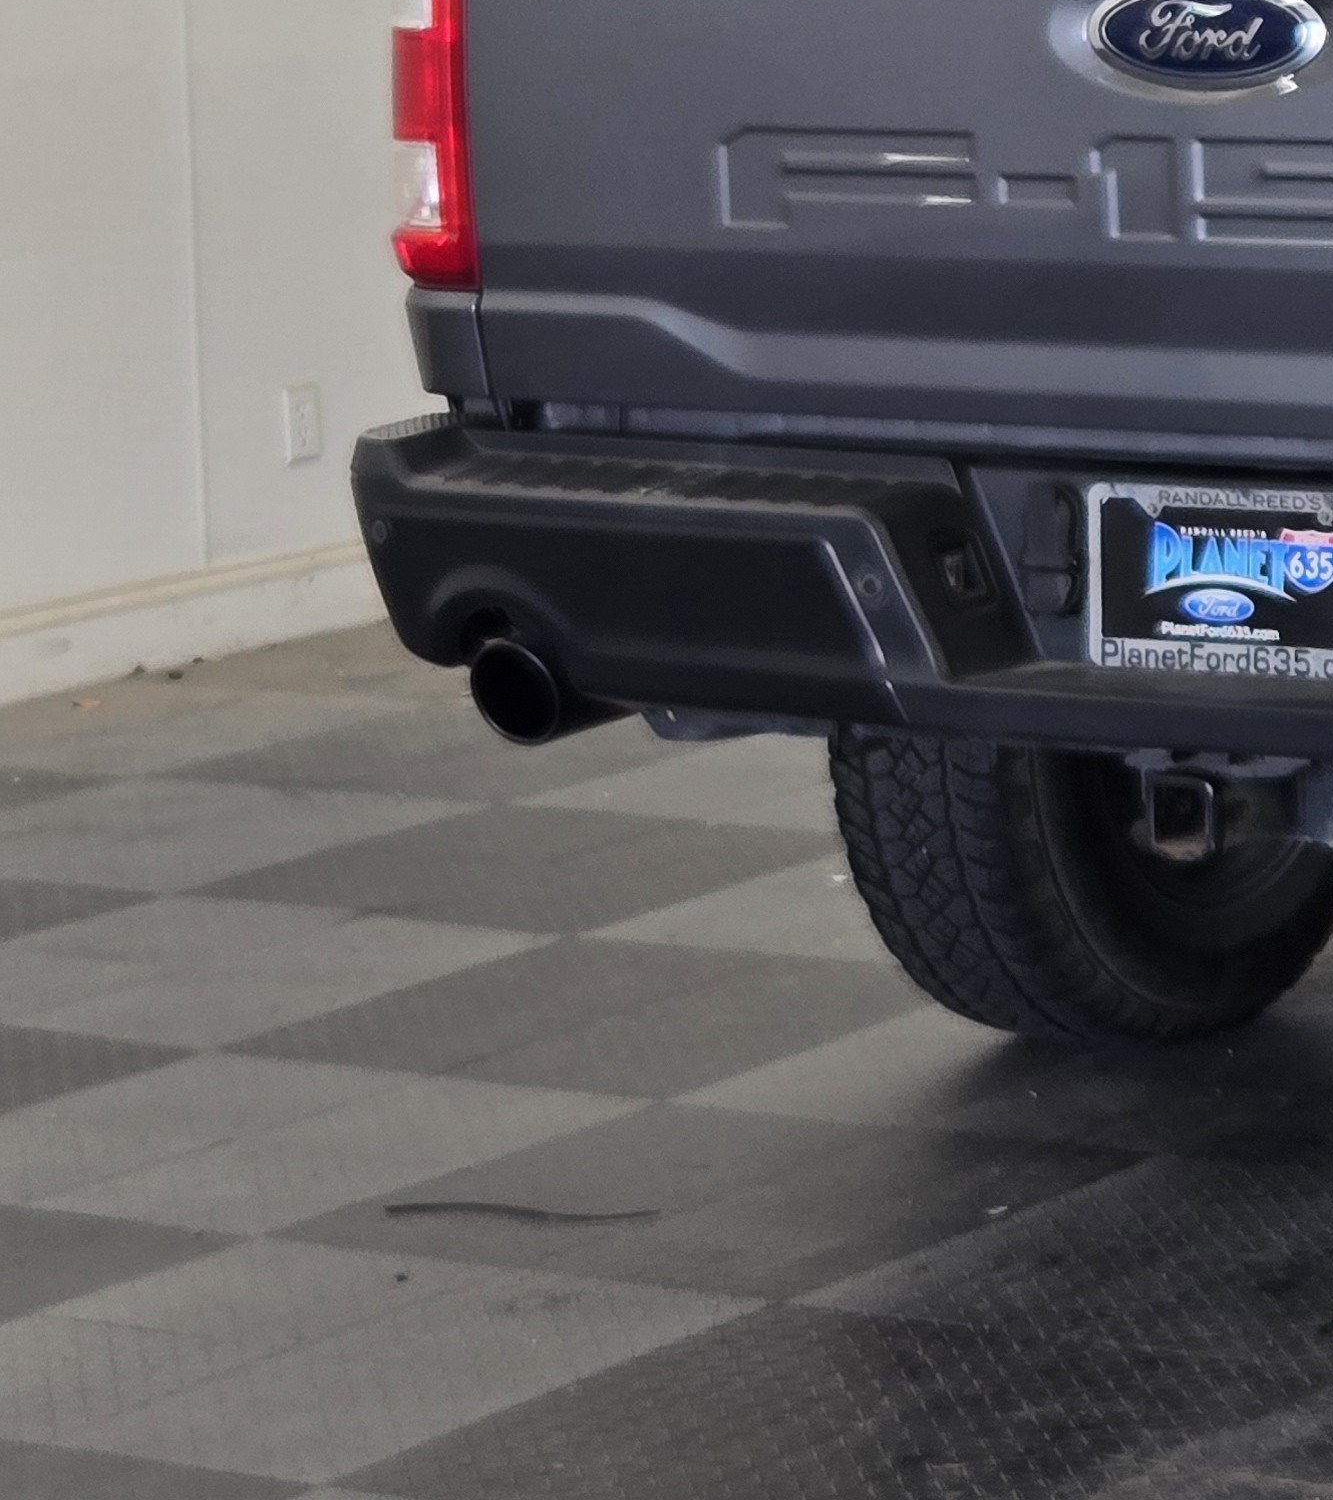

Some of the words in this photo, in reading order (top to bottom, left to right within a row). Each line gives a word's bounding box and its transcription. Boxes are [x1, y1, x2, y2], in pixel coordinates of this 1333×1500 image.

[1138, 0, 1264, 59] Ford
[1158, 490, 1247, 507] RANDALL
[1252, 493, 1323, 511] REED'S
[1154, 522, 1288, 592] PLANET
[1289, 551, 1333, 581] 635
[1198, 597, 1241, 619] Ford
